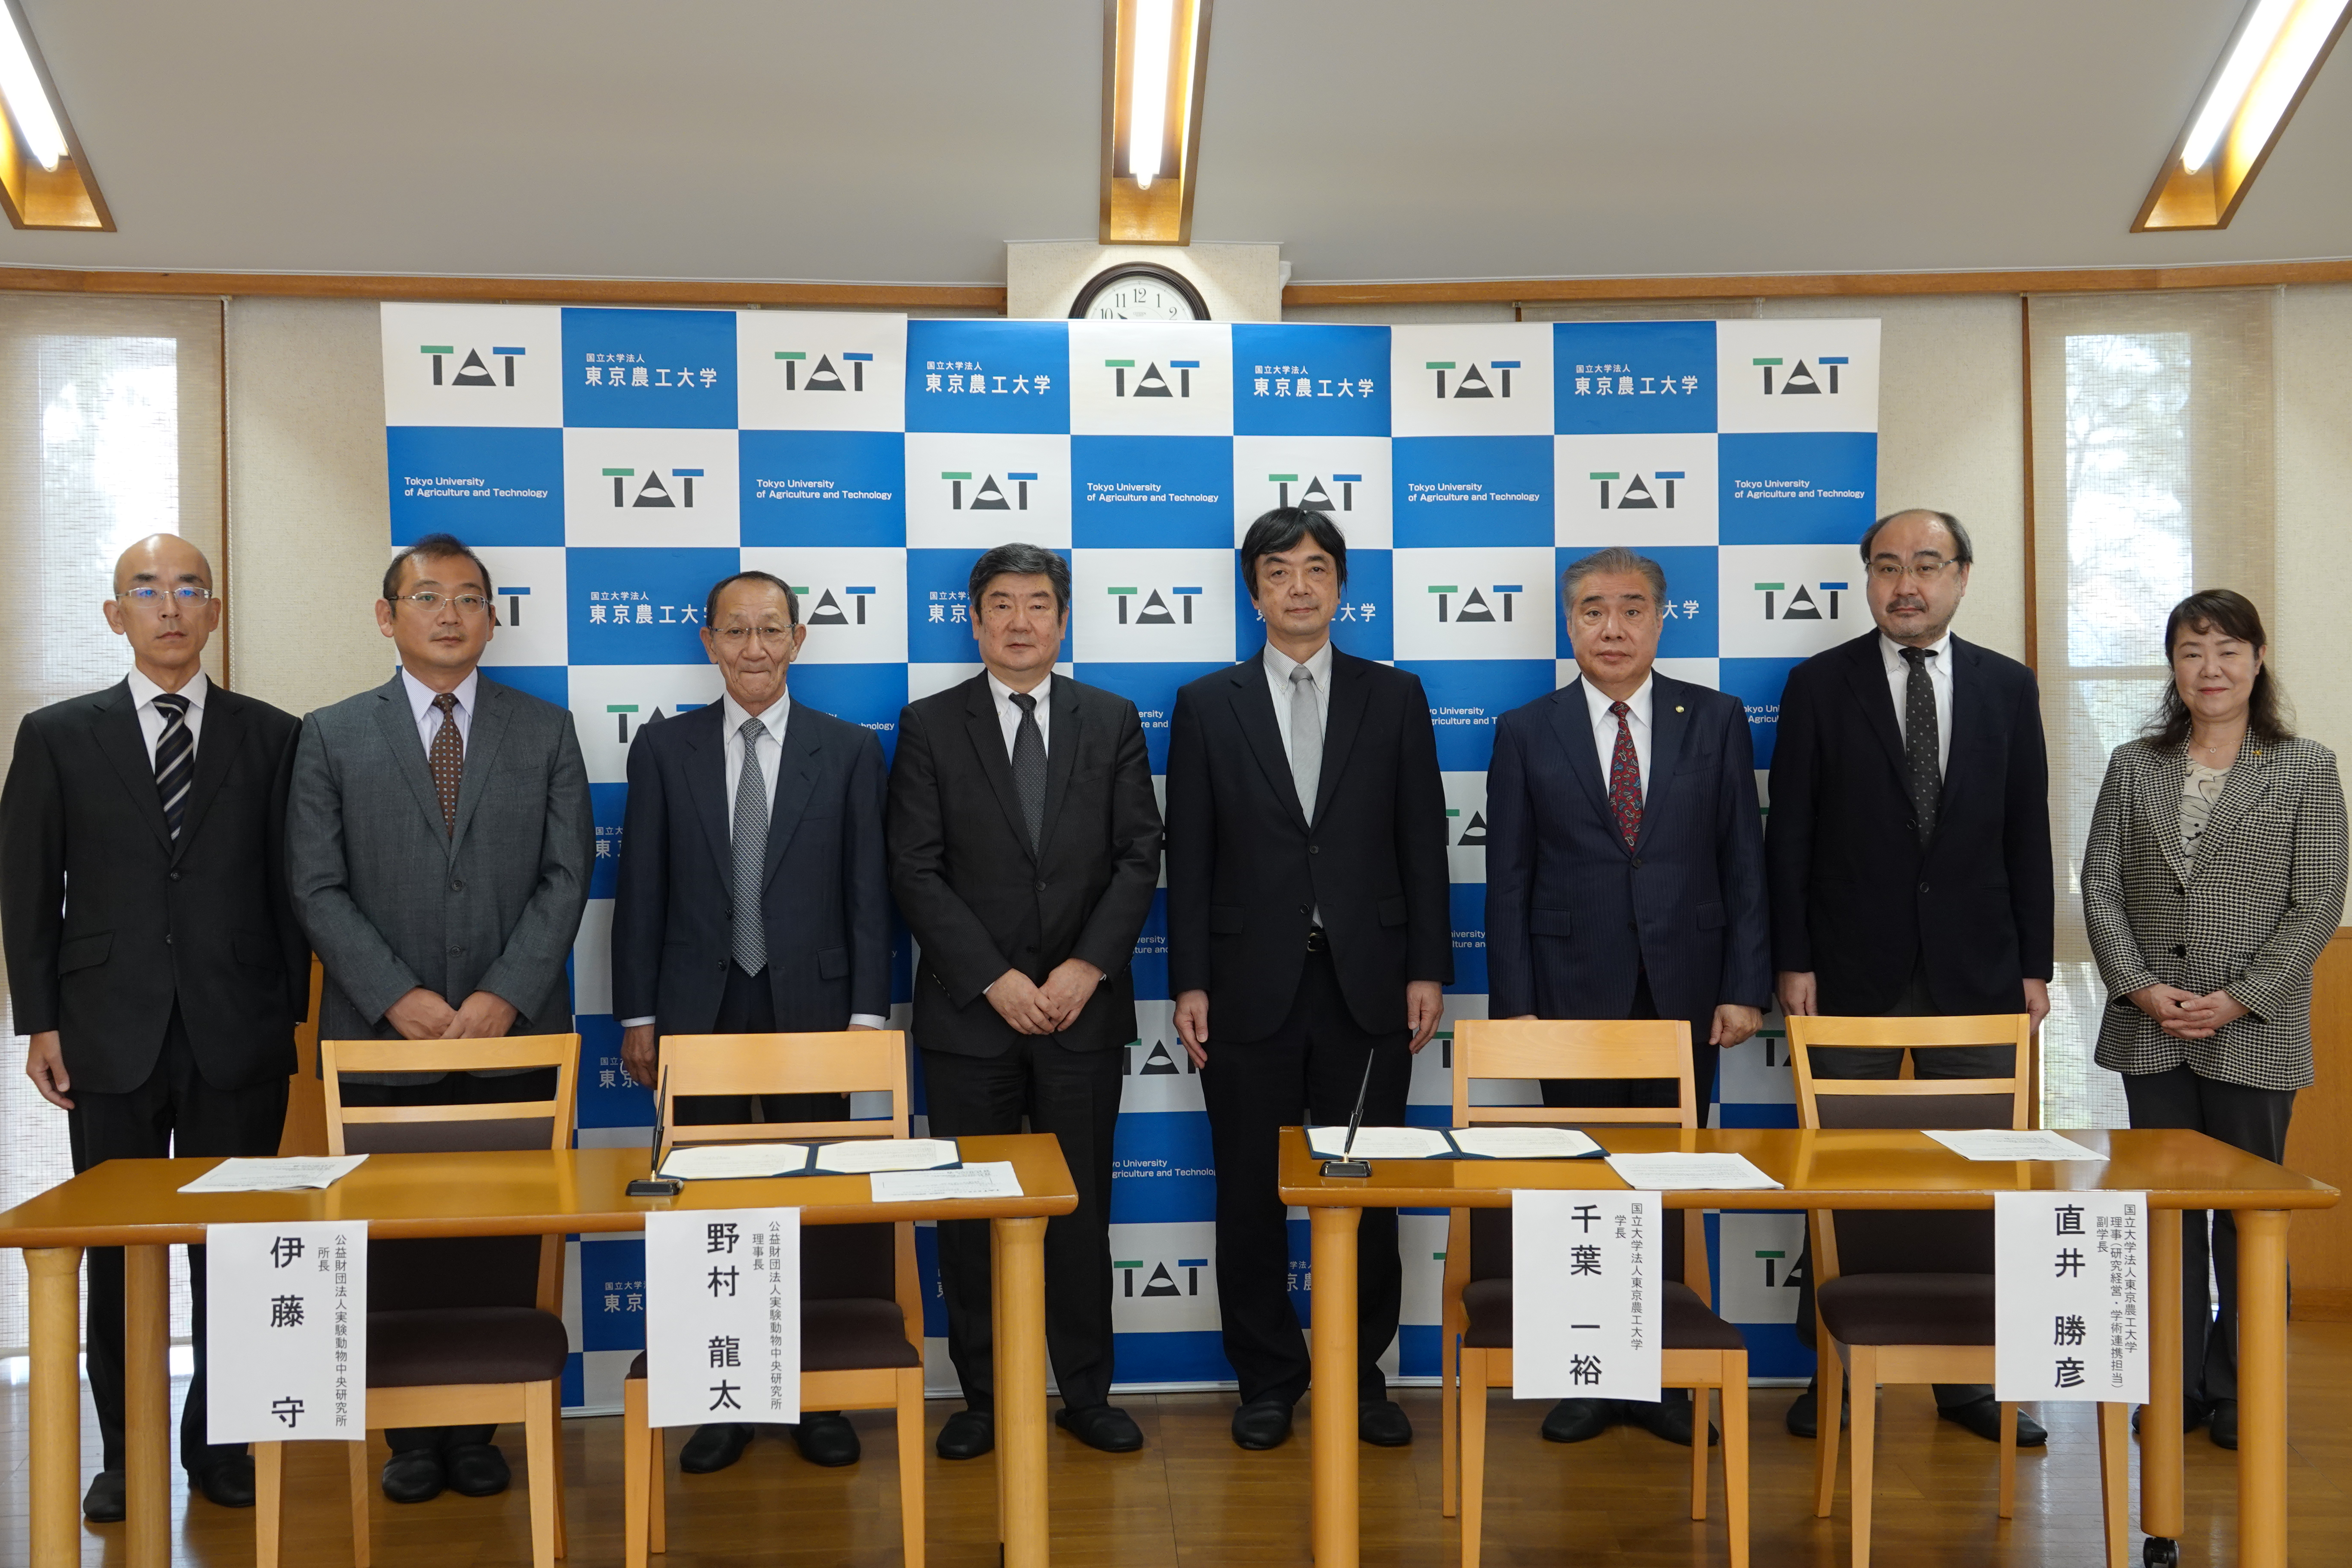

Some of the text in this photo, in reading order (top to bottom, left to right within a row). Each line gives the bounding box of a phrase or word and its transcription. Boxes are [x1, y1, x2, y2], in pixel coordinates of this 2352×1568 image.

[1116, 293, 1126, 308] 11
[1133, 288, 1146, 303] 12
[1157, 293, 1161, 308] 1
[1100, 308, 1113, 319] 10
[1169, 307, 1177, 320] 2
[421, 345, 526, 387] TAT
[586, 353, 645, 363] 国立大学法人
[927, 361, 982, 371] 国立大学法人
[1576, 364, 1631, 373] 国立大学法人
[585, 366, 717, 388] 東京農工大学
[775, 352, 873, 392] TAT
[1105, 359, 1200, 398] TAT
[1255, 365, 1308, 374] 国立大学法人
[1426, 361, 1521, 398] TAT
[1753, 357, 1849, 395] TAT
[925, 374, 1050, 395] 東京農工大学
[1253, 377, 1374, 398] 東京農工大学
[1574, 375, 1698, 396] 東京農工大学
[404, 477, 485, 487] Tokyo University
[602, 468, 704, 508] TAT
[756, 479, 834, 489] Tokyo University
[941, 472, 1038, 510] TAT
[1087, 483, 1161, 492] Tokyo University
[1269, 474, 1362, 511] TAT
[1409, 483, 1482, 492] Tokyo University
[1590, 471, 1685, 509] TAT
[1735, 479, 1810, 489] Tokyo University
[404, 488, 414, 496] of
[416, 488, 470, 497] Agriculture
[493, 489, 548, 498] Technology
[756, 490, 892, 500] of Agriculture and Technology
[1087, 493, 1219, 502] of Agriculture and Technology
[1408, 493, 1540, 502] of Agriculture and Technology
[1735, 489, 1865, 499] of Agriculture and Technology
[591, 591, 649, 600] 国立大学法人
[930, 591, 971, 600] 国立大学
[1108, 587, 1203, 625] TAT
[1428, 585, 1523, 622] TAT
[1755, 582, 1848, 620] TAT
[589, 604, 707, 625] 東京農工大
[1138, 710, 1164, 719] ersity
[1431, 717, 1471, 726] griculture
[1440, 707, 1484, 715] University
[1112, 1170, 1154, 1179] griculture
[1175, 1168, 1216, 1176] Technolo
[1123, 1159, 1167, 1167] University
[1615, 1215, 1626, 1239] 学長
[2096, 1216, 2108, 1253] 副学長
[318, 1247, 330, 1272] 所長
[752, 1234, 764, 1271] 理事長
[605, 1281, 646, 1290] 国立大学
[1114, 1259, 1208, 1297] TAT
[1631, 1203, 1643, 1351] 国立大学法人東京農工大学
[2124, 1204, 2137, 1353] 国立大学法人東京農工大学
[1569, 1204, 1602, 1385] 千葉 一裕
[2054, 1204, 2086, 1388] 直井 勝彦
[707, 1223, 741, 1411] 野村 龍太
[769, 1221, 782, 1410] 公益財団法人実験動物中央研究所
[270, 1236, 305, 1428] 伊藤 守
[335, 1234, 347, 1427] 公益財団法人実験動物中央研究所
